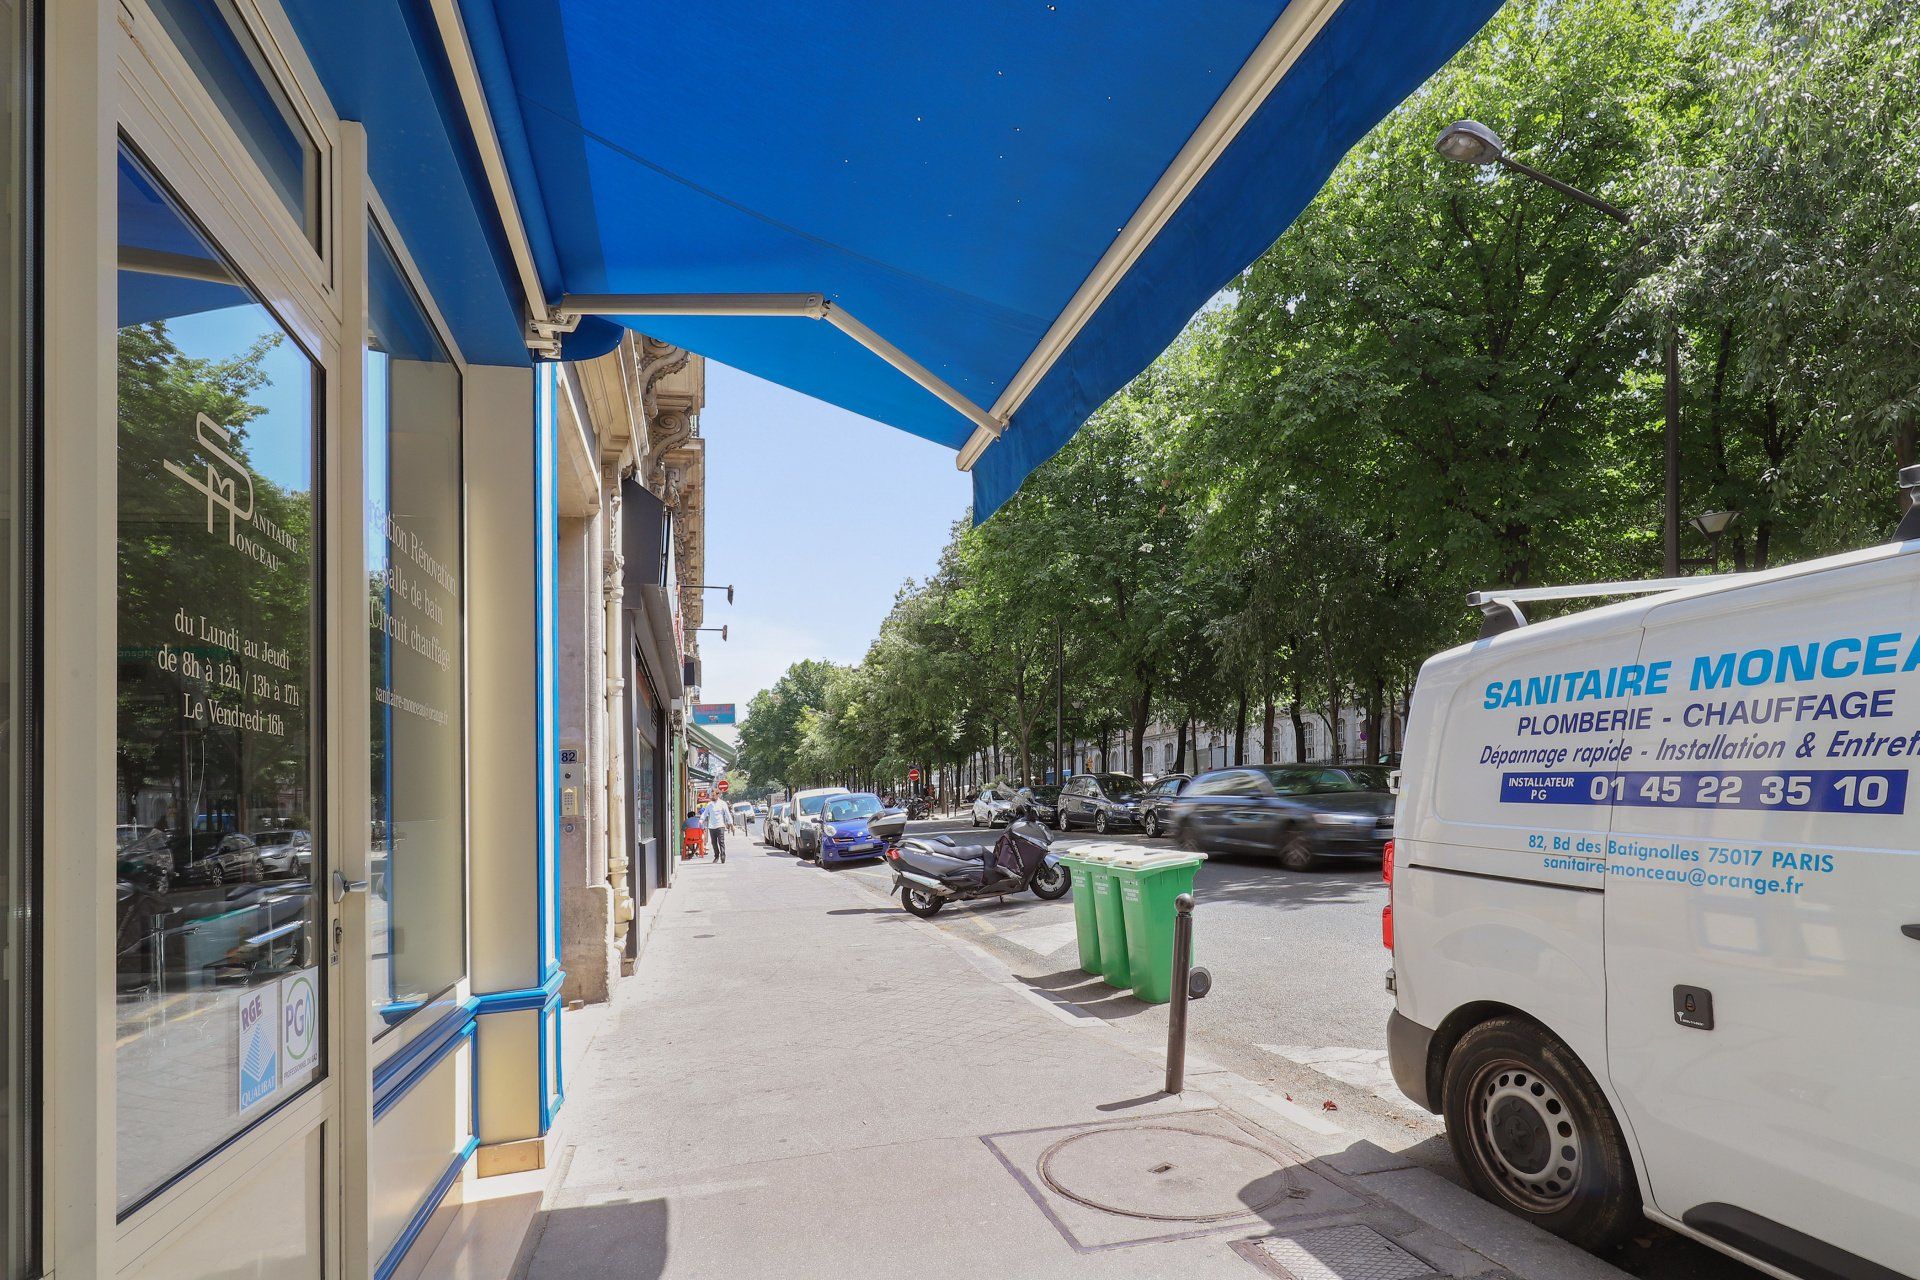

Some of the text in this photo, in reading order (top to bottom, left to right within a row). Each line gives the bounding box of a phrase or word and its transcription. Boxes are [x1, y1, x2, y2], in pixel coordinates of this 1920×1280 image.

[411, 531, 456, 597] Rénovation
[382, 556, 443, 625] Salle de bain
[174, 607, 290, 671] du Lundi au Jeudi
[370, 597, 451, 672] Circuit chauffage
[158, 643, 299, 707] de 8h à 12h / 13h à 17h
[1483, 661, 1672, 710] SANITAIRE
[183, 692, 285, 737] Le Vendredi 16h
[1517, 707, 1653, 736] PLOMBERIE
[1683, 689, 1896, 728] CHAUFFAGE
[561, 752, 576, 762] 82
[1480, 744, 1567, 769] Dépannage
[1572, 738, 1632, 768] rapide
[1655, 733, 1786, 761] Installation
[1795, 731, 1816, 759] &
[1508, 776, 1889, 807] INSTALLATEUR 01 45 22 35 10
[1530, 789, 1547, 801] PG
[1528, 834, 1834, 873] 82, Bd des Batignolles 75017 PARIS
[1543, 855, 1805, 895] sanitaire-monceau@orange.fr
[241, 994, 262, 1031] RGE
